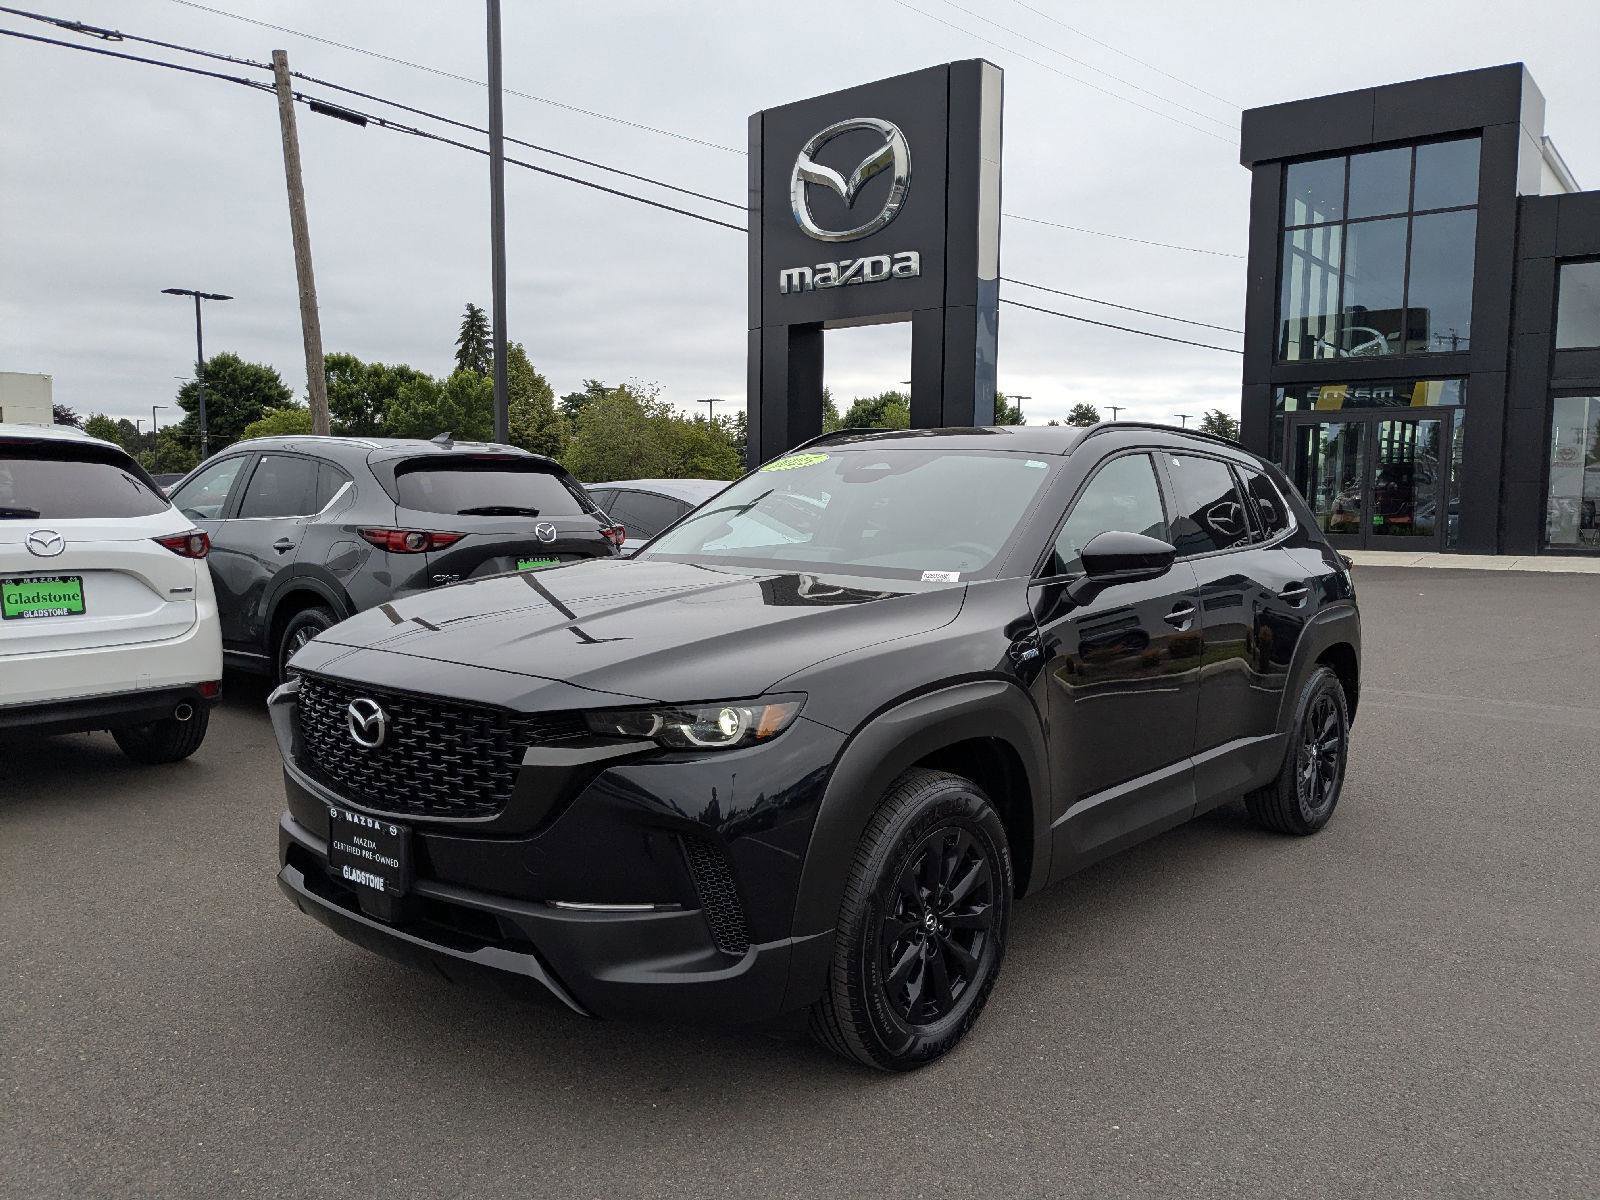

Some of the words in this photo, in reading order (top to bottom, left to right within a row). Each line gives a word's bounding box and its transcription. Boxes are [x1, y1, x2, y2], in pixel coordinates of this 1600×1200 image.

[6, 592, 80, 605] Gladstone
[23, 608, 69, 618] GLADSTONE
[345, 812, 380, 830] MAZDA
[353, 836, 377, 849] MAZDA
[333, 841, 361, 856] CERTIFIED
[362, 850, 399, 867] PRE-OWNED
[343, 865, 384, 891] GLADSTONE
